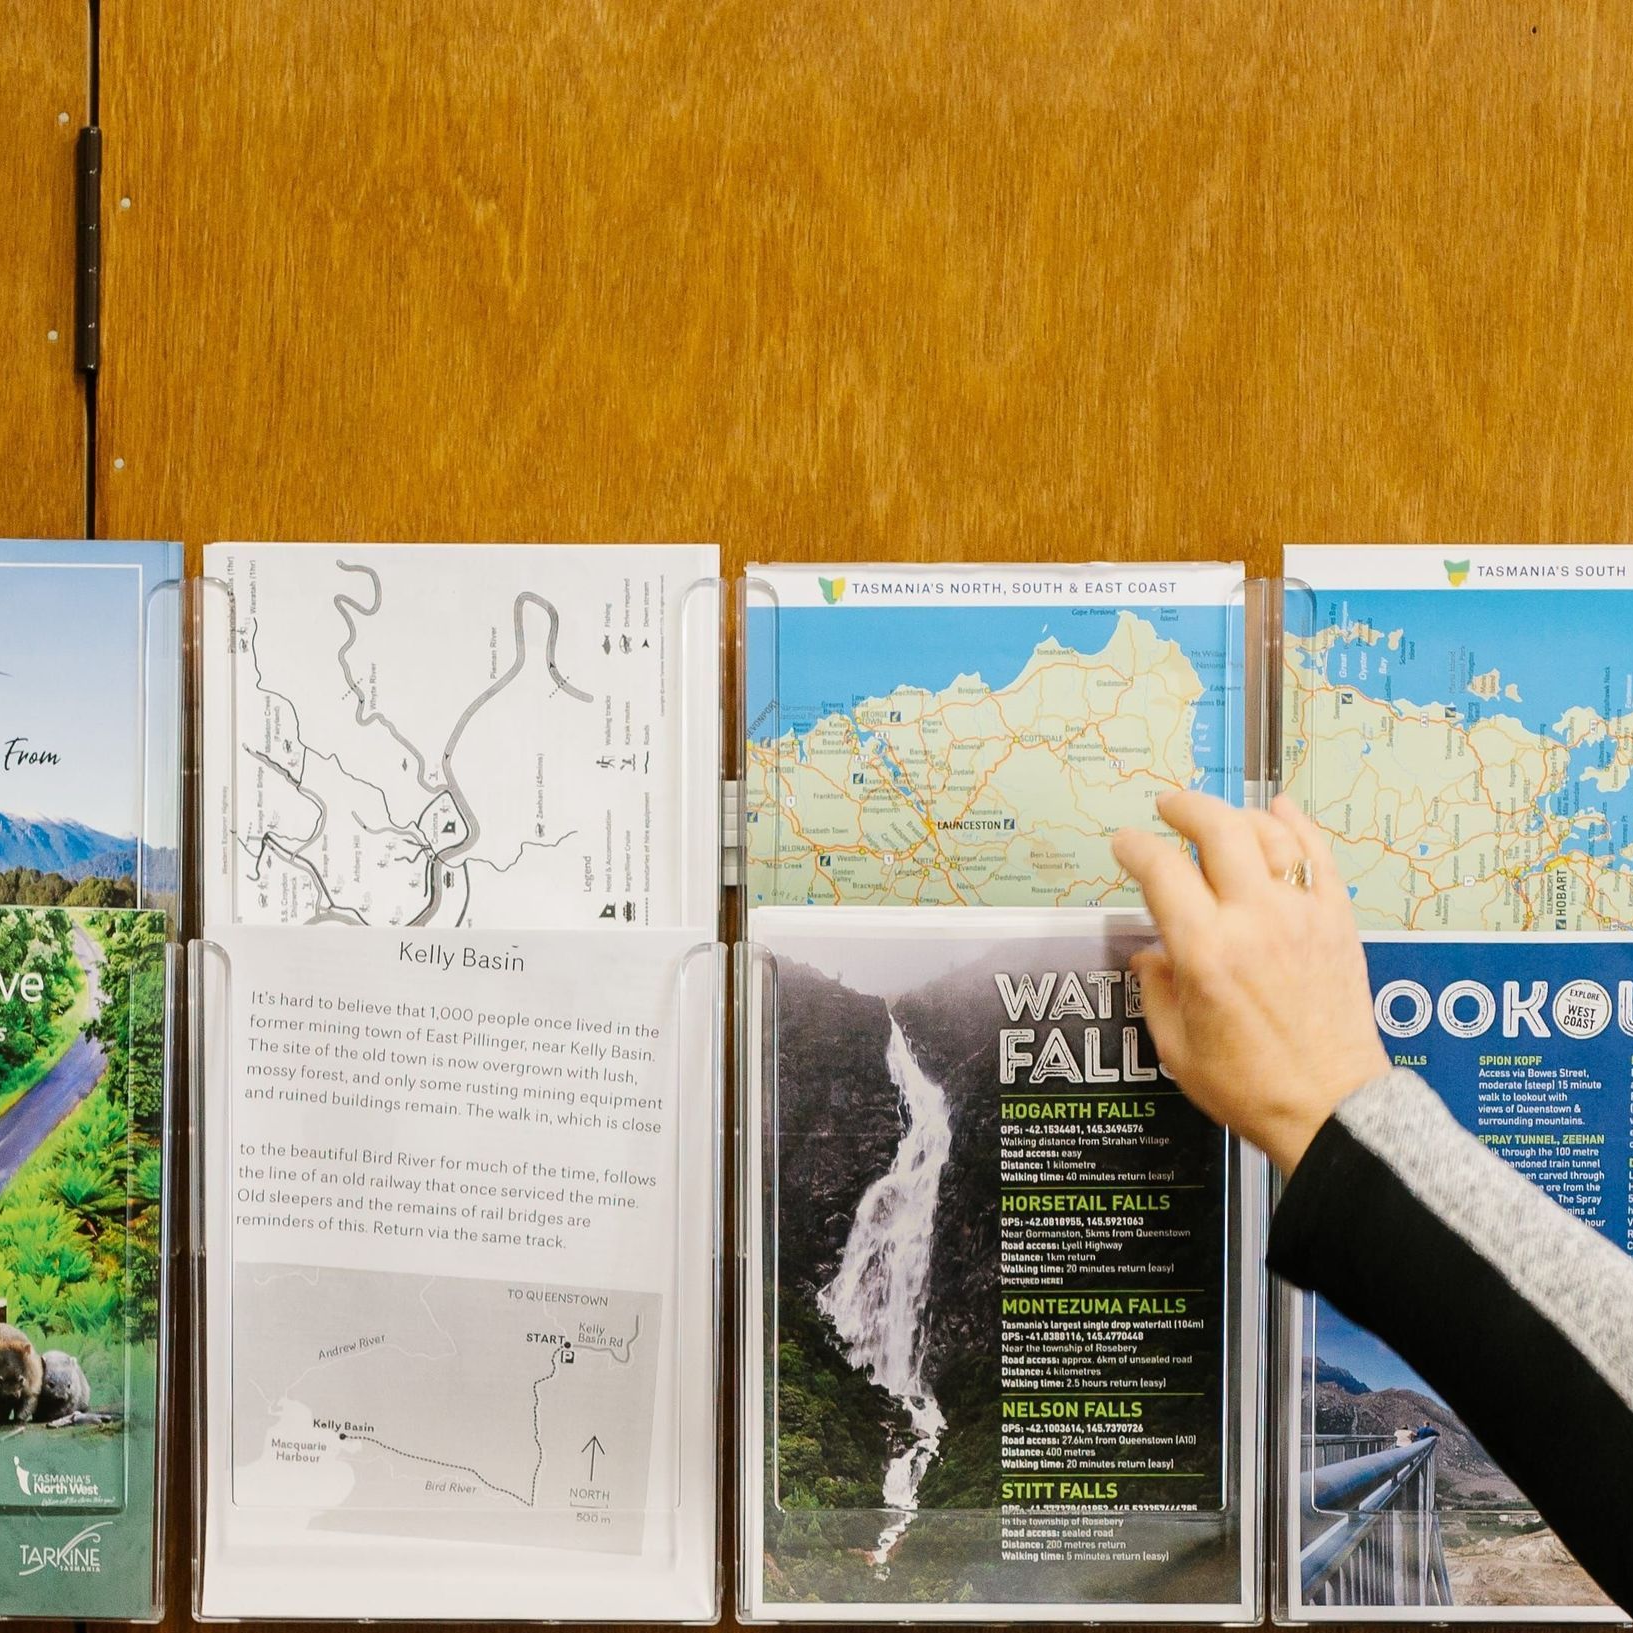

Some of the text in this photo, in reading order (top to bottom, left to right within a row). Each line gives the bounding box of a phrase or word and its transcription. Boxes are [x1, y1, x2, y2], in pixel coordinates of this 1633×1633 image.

[1477, 565, 1626, 578] TASMANIA'S SOUTH
[852, 581, 1177, 596] TASMANIA'S NORTH, SOUTH & EAST COAST
[369, 662, 378, 711] Whyte River
[4, 737, 61, 771] From
[937, 820, 1001, 830] LAUNCESTON
[1556, 869, 1567, 917] HOBART
[399, 941, 525, 972] Kelly Basin
[1479, 1055, 1542, 1066] SPION KOPF
[245, 1064, 662, 1110] mossy forest, and only some rusting mining equipment
[1001, 1102, 1155, 1119] HOGARTH FALLS
[1002, 1195, 1170, 1211] HORSETAIL FALLS
[526, 1333, 564, 1344] START
[32, 1473, 91, 1484] TASMANIA'S
[34, 1482, 99, 1496] North West
[1002, 1483, 1117, 1499] STITT FALLS
[20, 1544, 100, 1567] TARKINE
